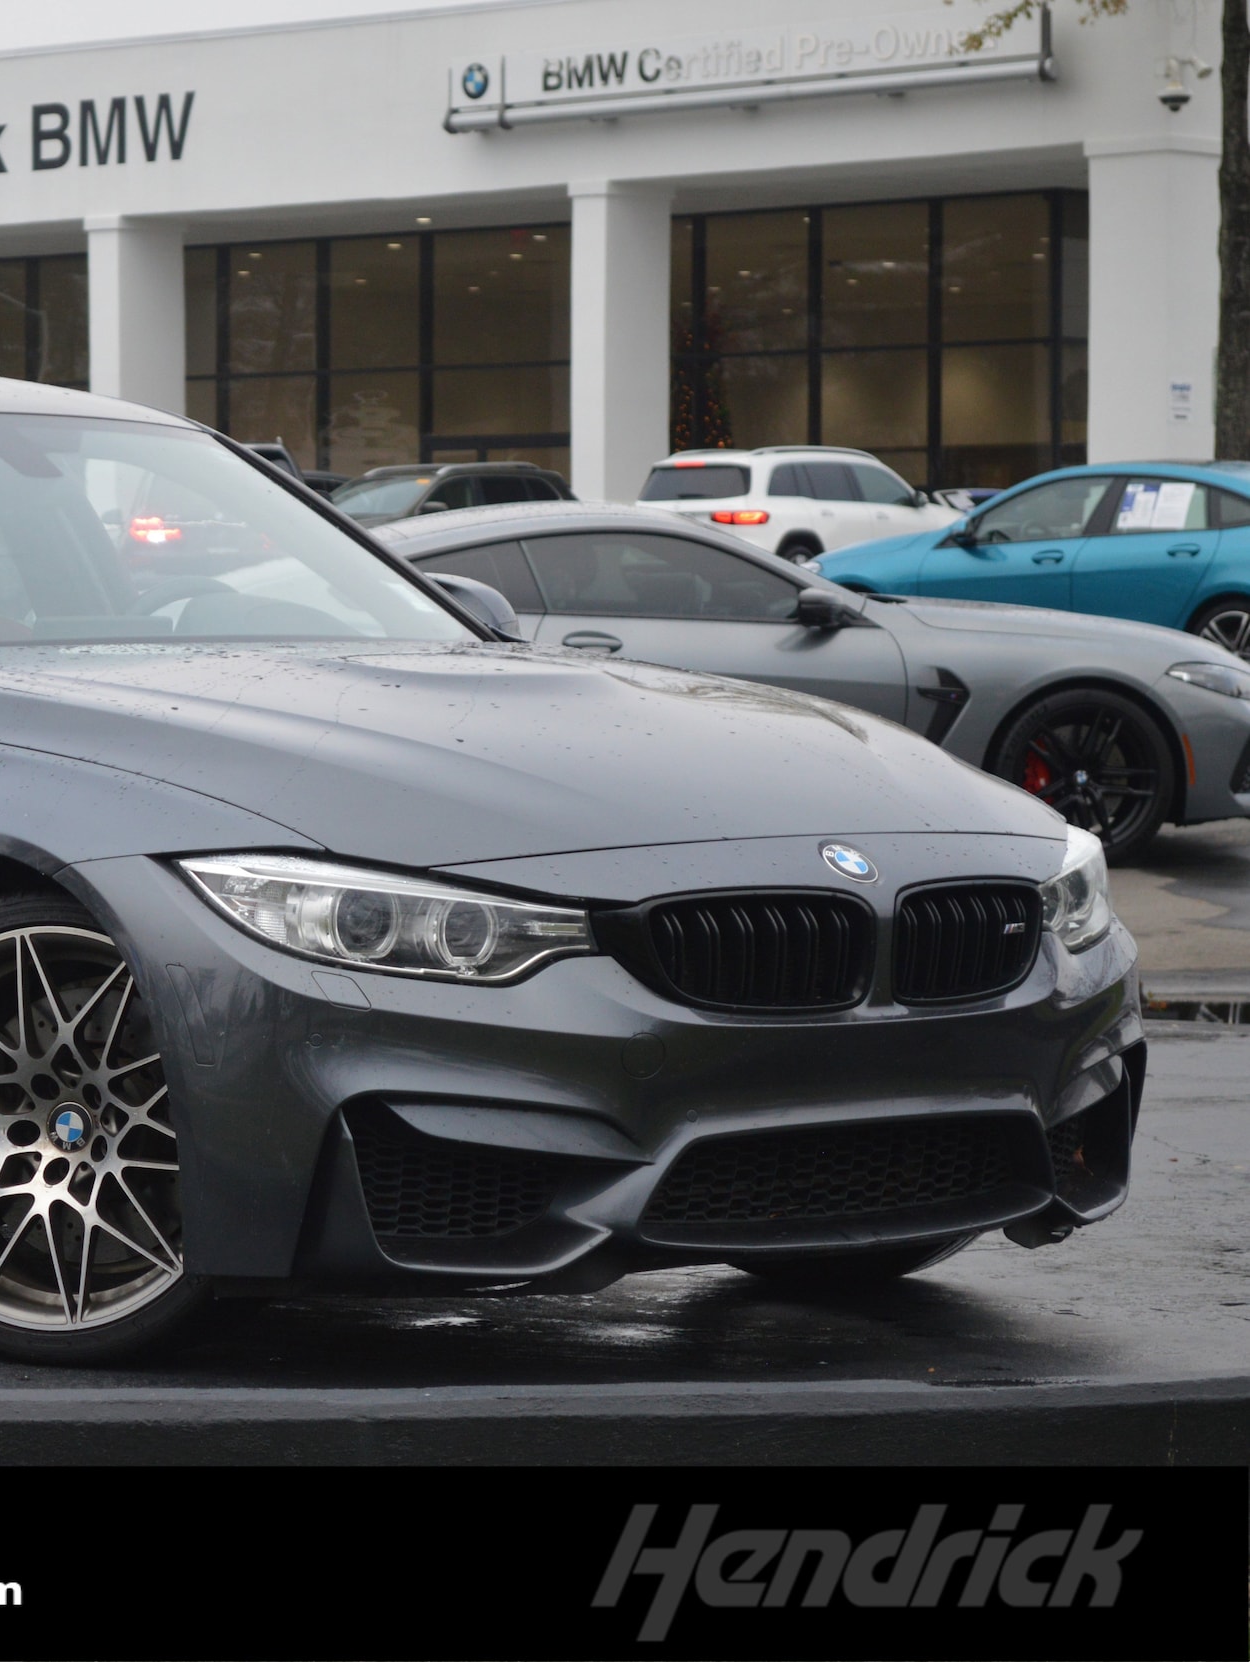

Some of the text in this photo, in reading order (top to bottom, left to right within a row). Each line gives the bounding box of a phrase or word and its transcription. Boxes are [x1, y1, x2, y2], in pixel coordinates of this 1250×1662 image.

[542, 50, 629, 92] BMW
[636, 35, 786, 84] Certified
[31, 91, 196, 172] BMW
